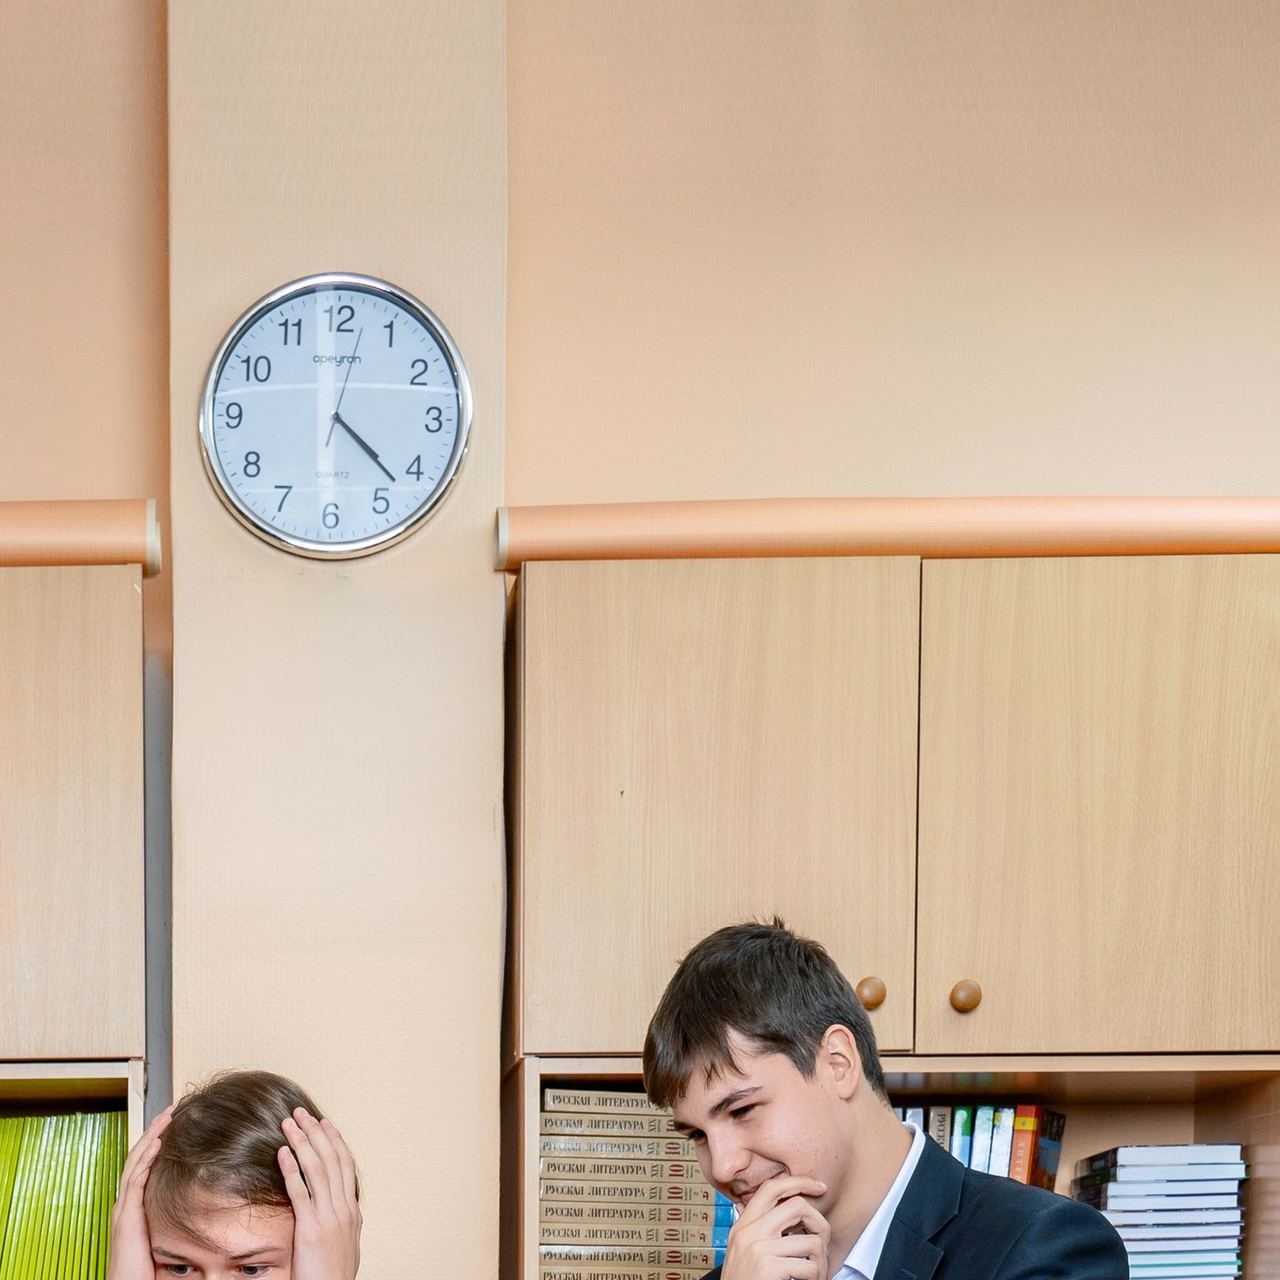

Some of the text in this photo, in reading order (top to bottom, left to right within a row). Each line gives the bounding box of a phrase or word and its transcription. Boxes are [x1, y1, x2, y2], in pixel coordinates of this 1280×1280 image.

[323, 305, 355, 333] 12
[278, 318, 302, 346] 11
[383, 320, 394, 348] 1
[313, 354, 362, 367] apeyron
[241, 356, 271, 382] 10
[410, 359, 429, 386] 2
[225, 402, 243, 429] 9
[424, 406, 443, 433] 3
[243, 451, 261, 478] 8
[406, 455, 424, 482] 4
[315, 471, 350, 479] QUARTZ
[274, 485, 293, 513] 7
[372, 488, 390, 514] 5
[322, 503, 340, 530] 6
[552, 1095, 590, 1106] РУССКАЯ
[544, 1118, 644, 1131] РУССКАЯ ЛИТЕРАТУРА
[648, 1119, 657, 1133] XIX
[543, 1141, 642, 1153] РУССКАЯ ЛИТЕРАТУРА
[647, 1142, 655, 1155] XIX
[665, 1142, 680, 1155] 10
[547, 1163, 646, 1175] РУССКАЯ ЛИТЕРАТУРА
[651, 1164, 659, 1177] XIX
[669, 1164, 684, 1178] 10
[546, 1185, 645, 1198] РУССКАЯ ЛИТЕРАТУРА
[649, 1187, 658, 1200] XIX
[667, 1186, 683, 1200] 10
[545, 1207, 644, 1219] РУССКАЯ ЛИТЕРАТУРА
[649, 1208, 657, 1221] XIX
[666, 1208, 682, 1222] 10
[542, 1228, 642, 1240] РУССКАЯ ЛИТЕРАТУРА
[646, 1229, 655, 1242] XIX
[664, 1228, 680, 1242] 10
[543, 1251, 644, 1262] РУССКАЯ ЛИТЕРАТУРА
[648, 1251, 656, 1264] XIX
[666, 1250, 682, 1264] 10
